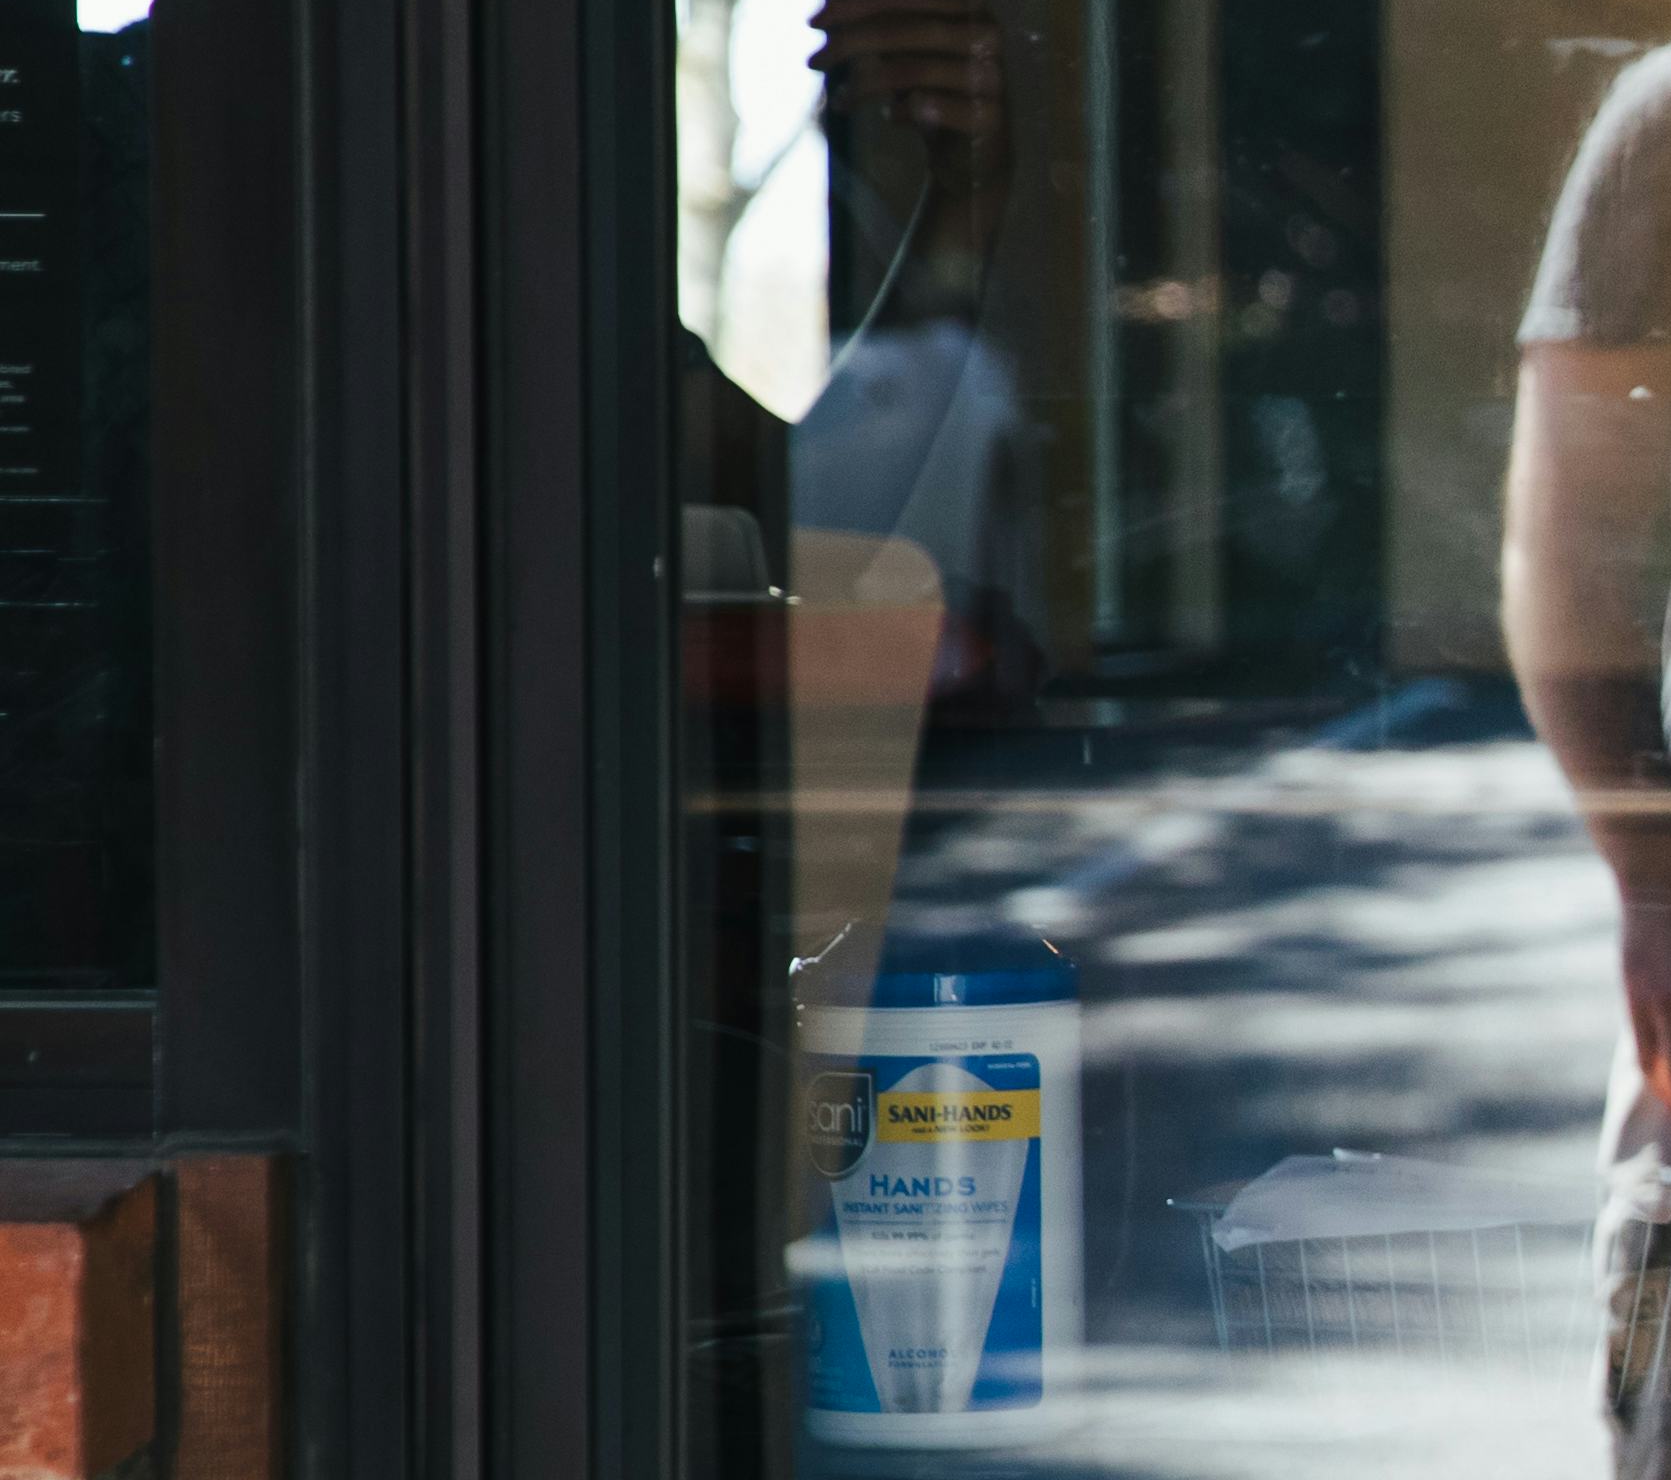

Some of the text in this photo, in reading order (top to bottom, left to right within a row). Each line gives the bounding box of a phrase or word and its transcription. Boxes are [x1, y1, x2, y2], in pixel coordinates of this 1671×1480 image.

[809, 1097, 864, 1133] sani
[889, 1104, 1012, 1124] SANI-HANDS
[870, 1174, 976, 1197] HANDS
[843, 1202, 889, 1214] INSTANT
[971, 1201, 1008, 1213] WIPES
[889, 1348, 950, 1359] ALCOHO
